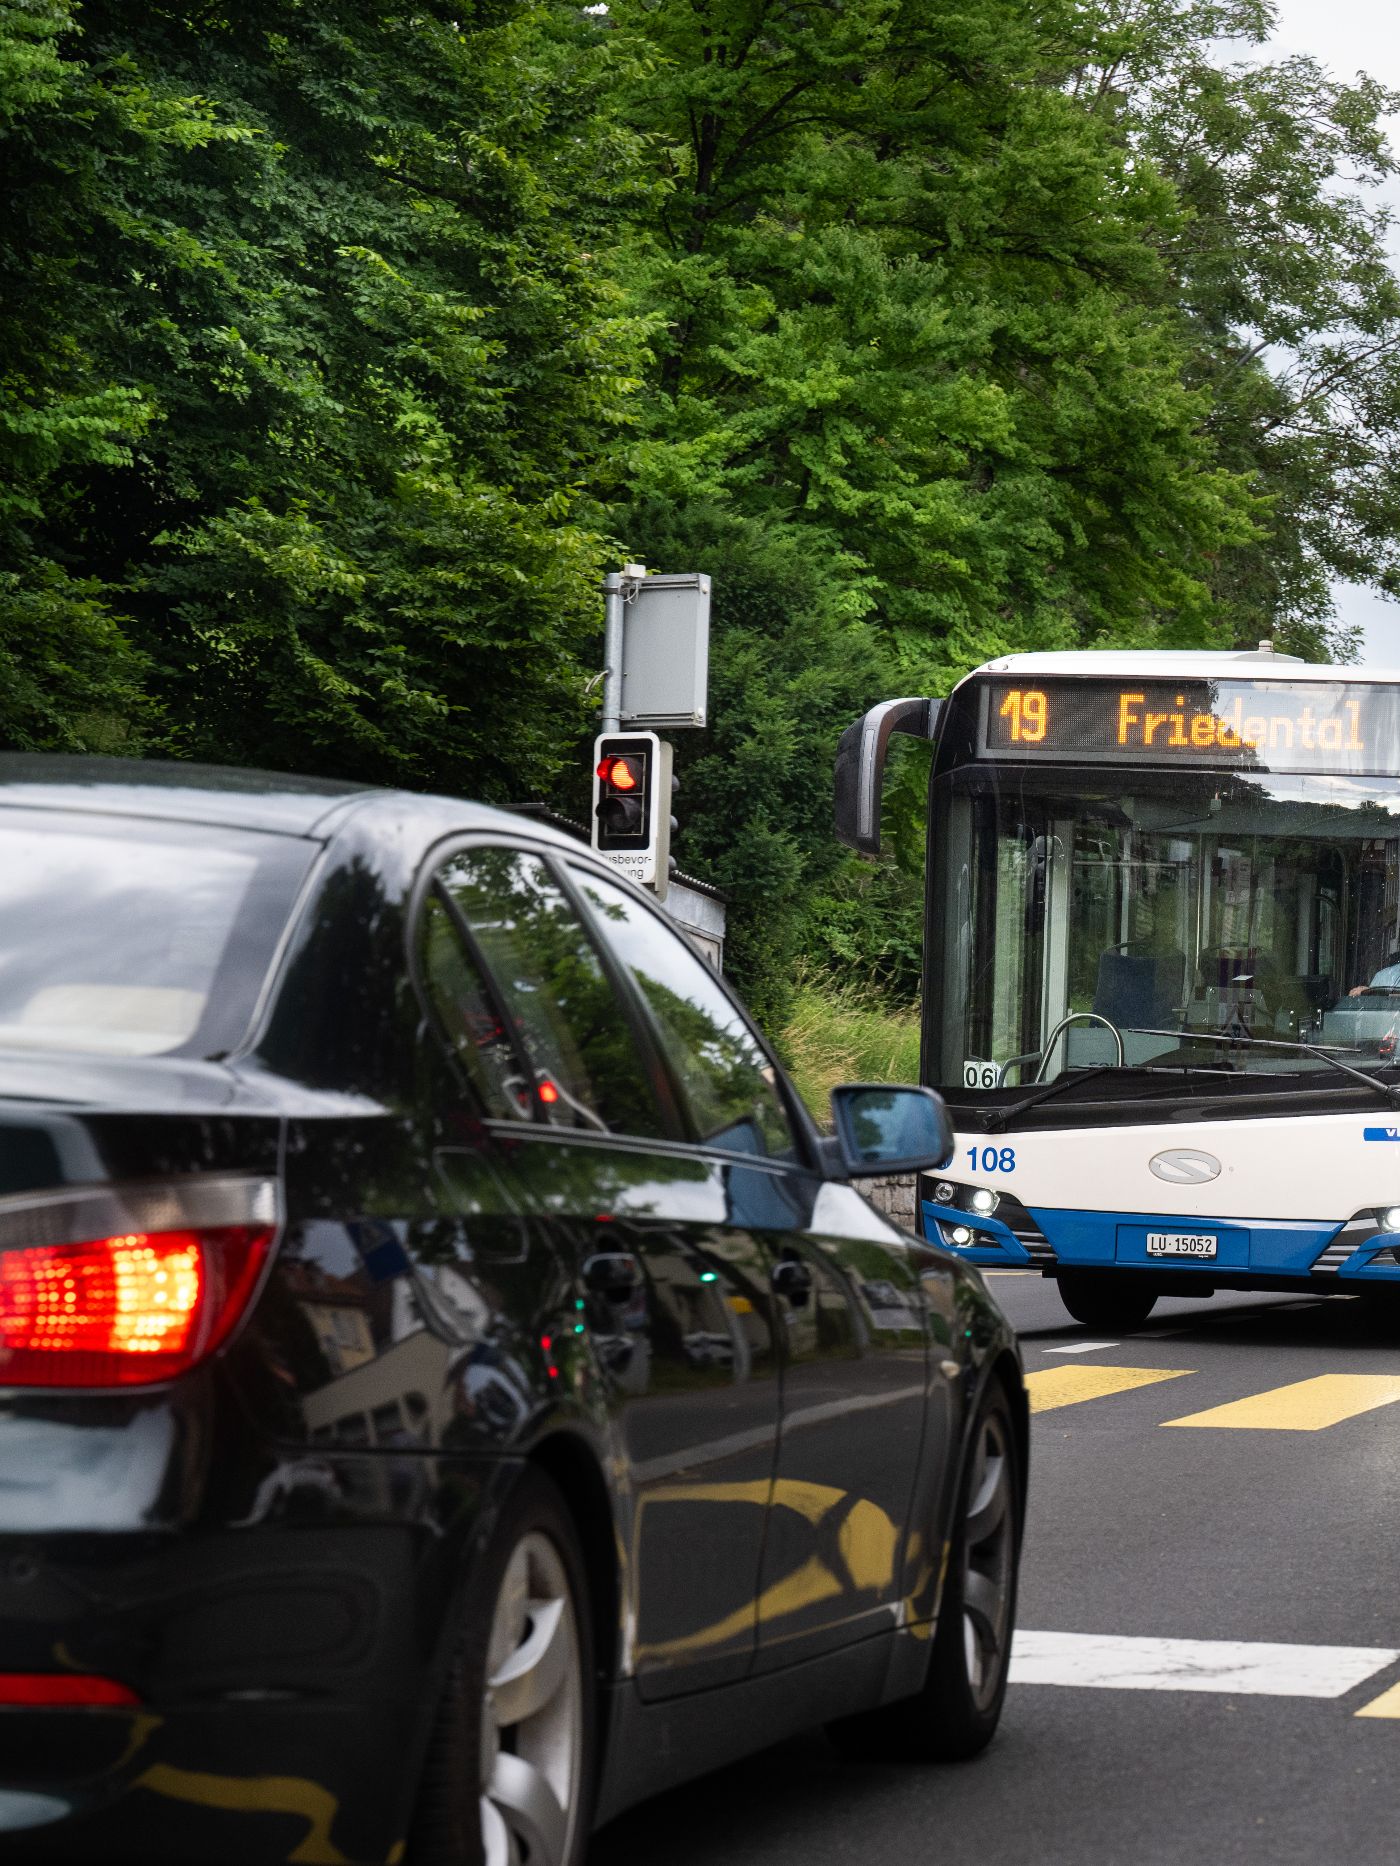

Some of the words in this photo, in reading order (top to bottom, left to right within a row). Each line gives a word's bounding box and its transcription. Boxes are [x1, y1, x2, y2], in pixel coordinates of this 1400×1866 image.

[1000, 690, 1047, 741] 19
[1117, 693, 1364, 750] Friedental
[967, 1146, 1016, 1173] 108
